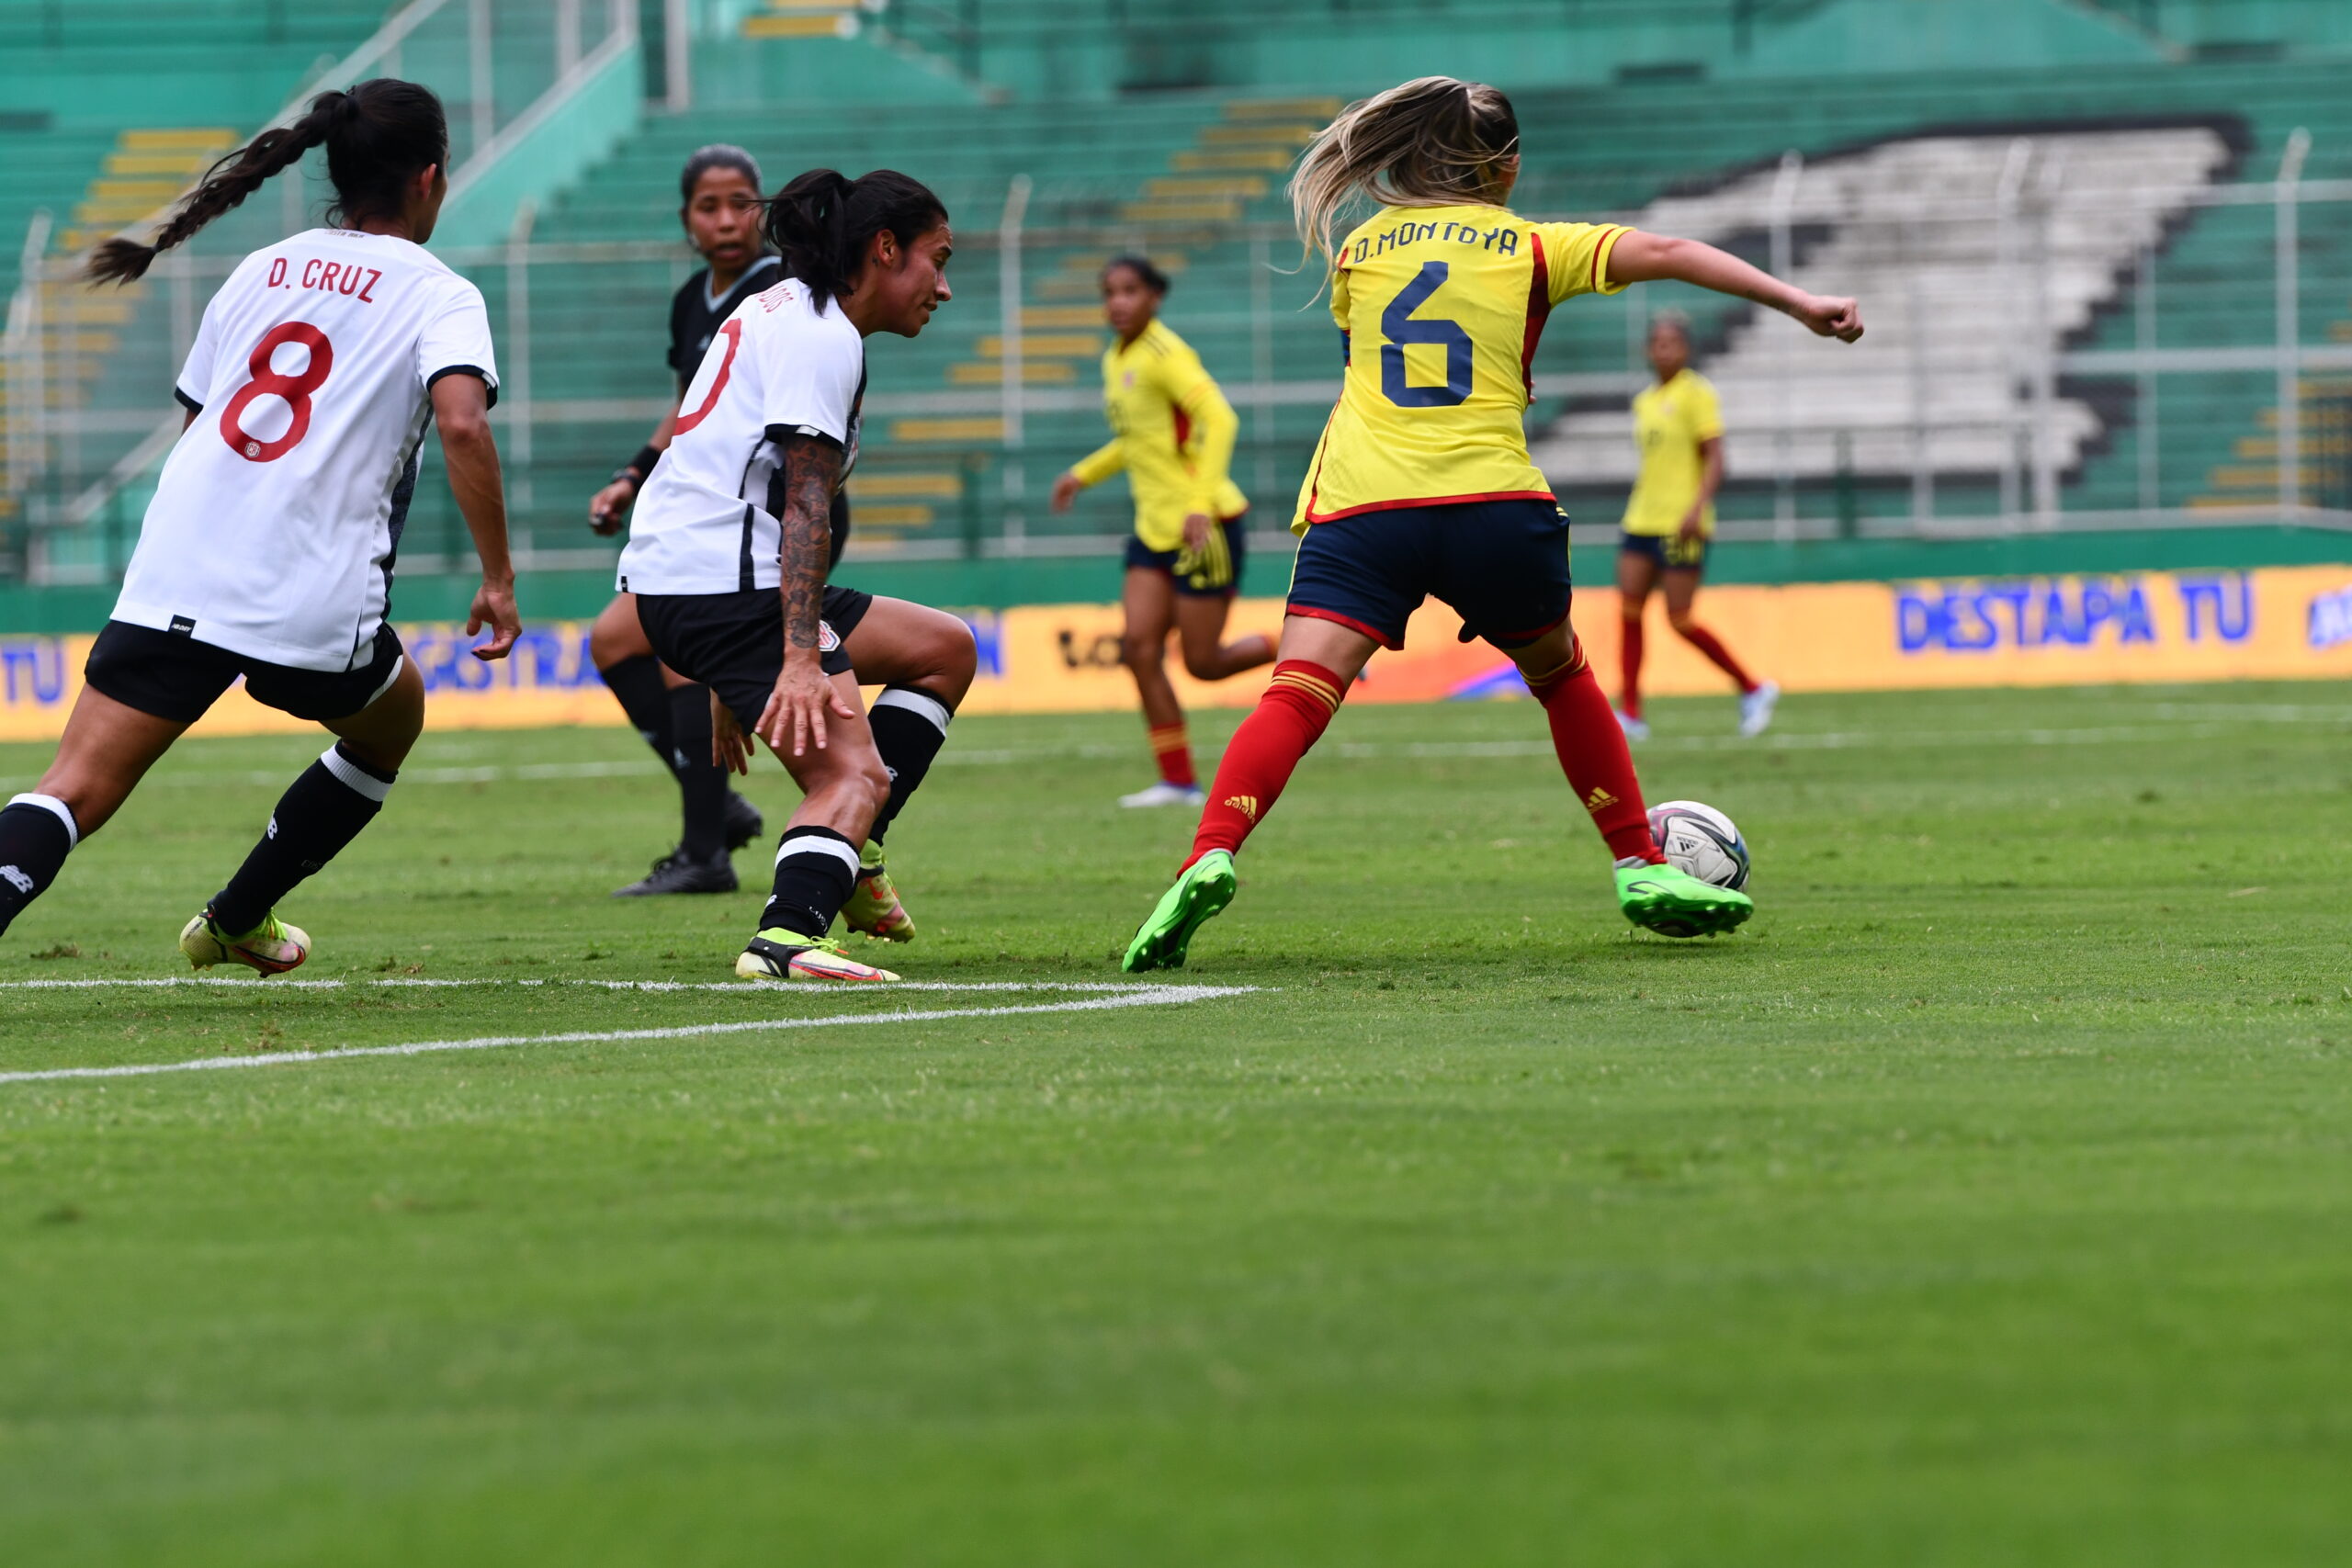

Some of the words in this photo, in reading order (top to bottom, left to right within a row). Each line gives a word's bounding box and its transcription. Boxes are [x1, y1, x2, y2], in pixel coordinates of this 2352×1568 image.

[1353, 222, 1518, 265] D.MONTOYA
[267, 258, 290, 289] D.
[302, 259, 382, 304] CRUZ
[1381, 261, 1473, 407] 6
[220, 321, 334, 462] 8
[1899, 581, 2154, 650] DESTAPA
[2178, 574, 2249, 640] TU
[2, 643, 62, 704] TU
